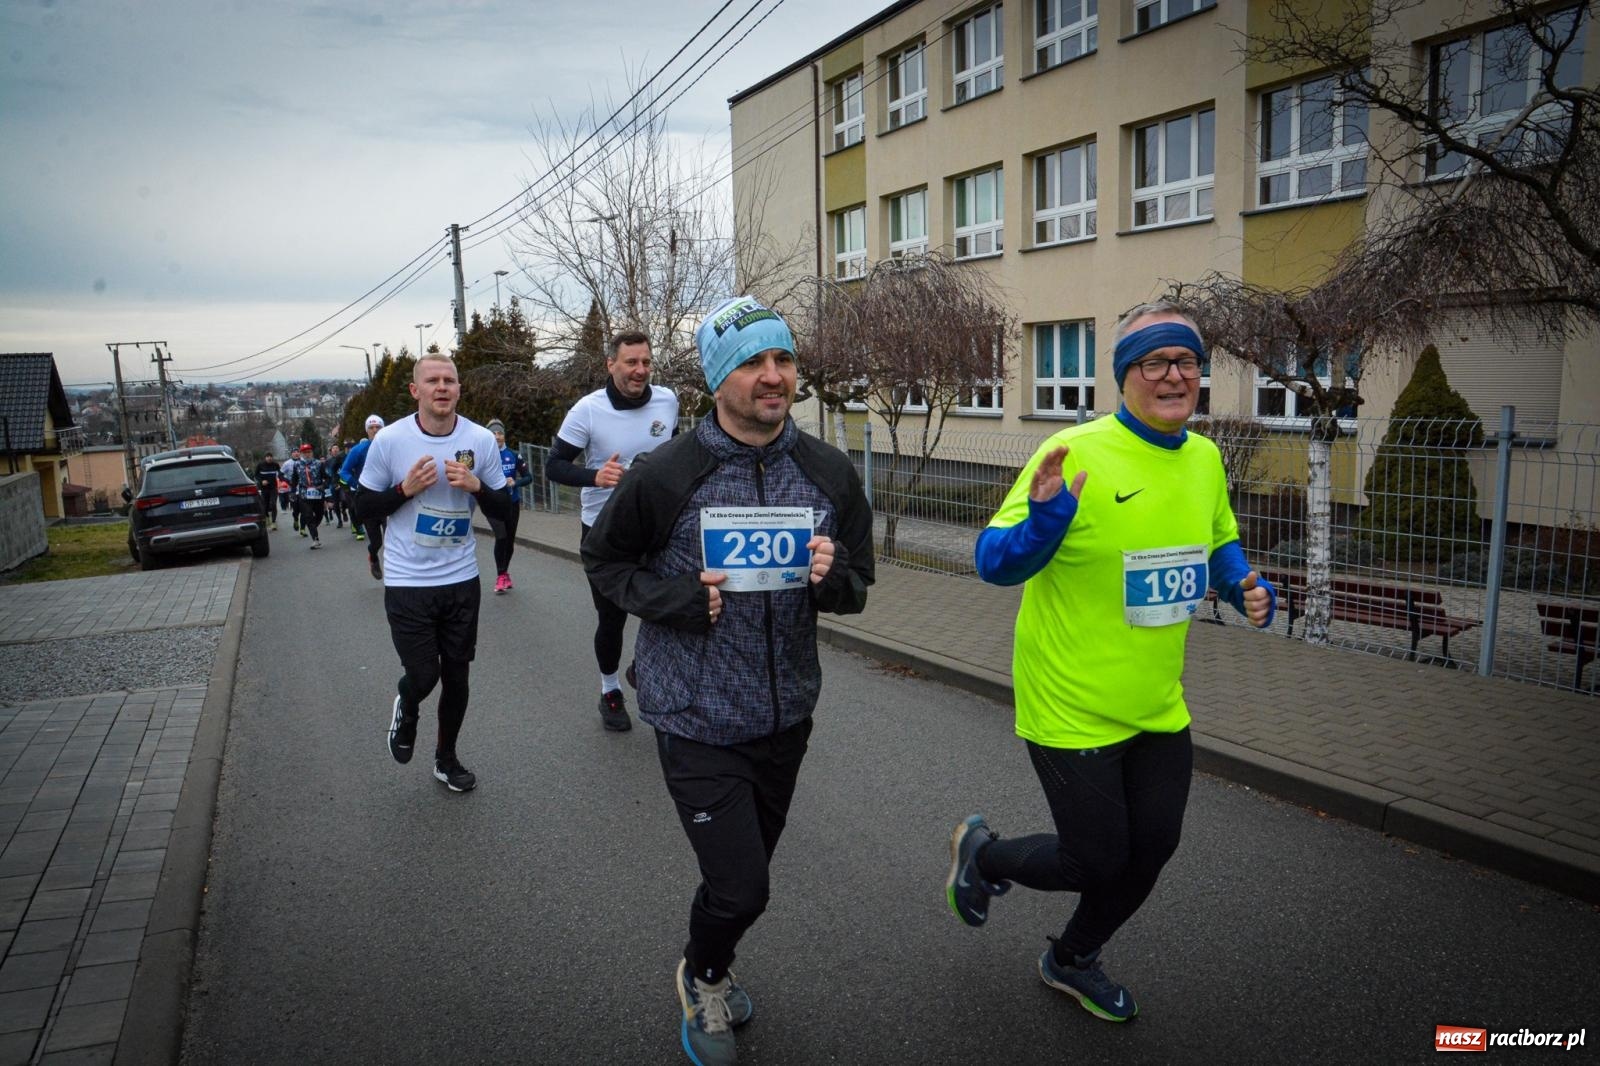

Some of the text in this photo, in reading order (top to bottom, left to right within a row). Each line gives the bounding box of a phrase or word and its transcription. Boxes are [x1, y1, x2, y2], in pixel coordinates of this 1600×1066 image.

[716, 308, 737, 325] EKO
[720, 311, 744, 330] PRZEZ
[431, 518, 457, 536] 46
[722, 530, 796, 566] 230
[1144, 567, 1197, 603] 198
